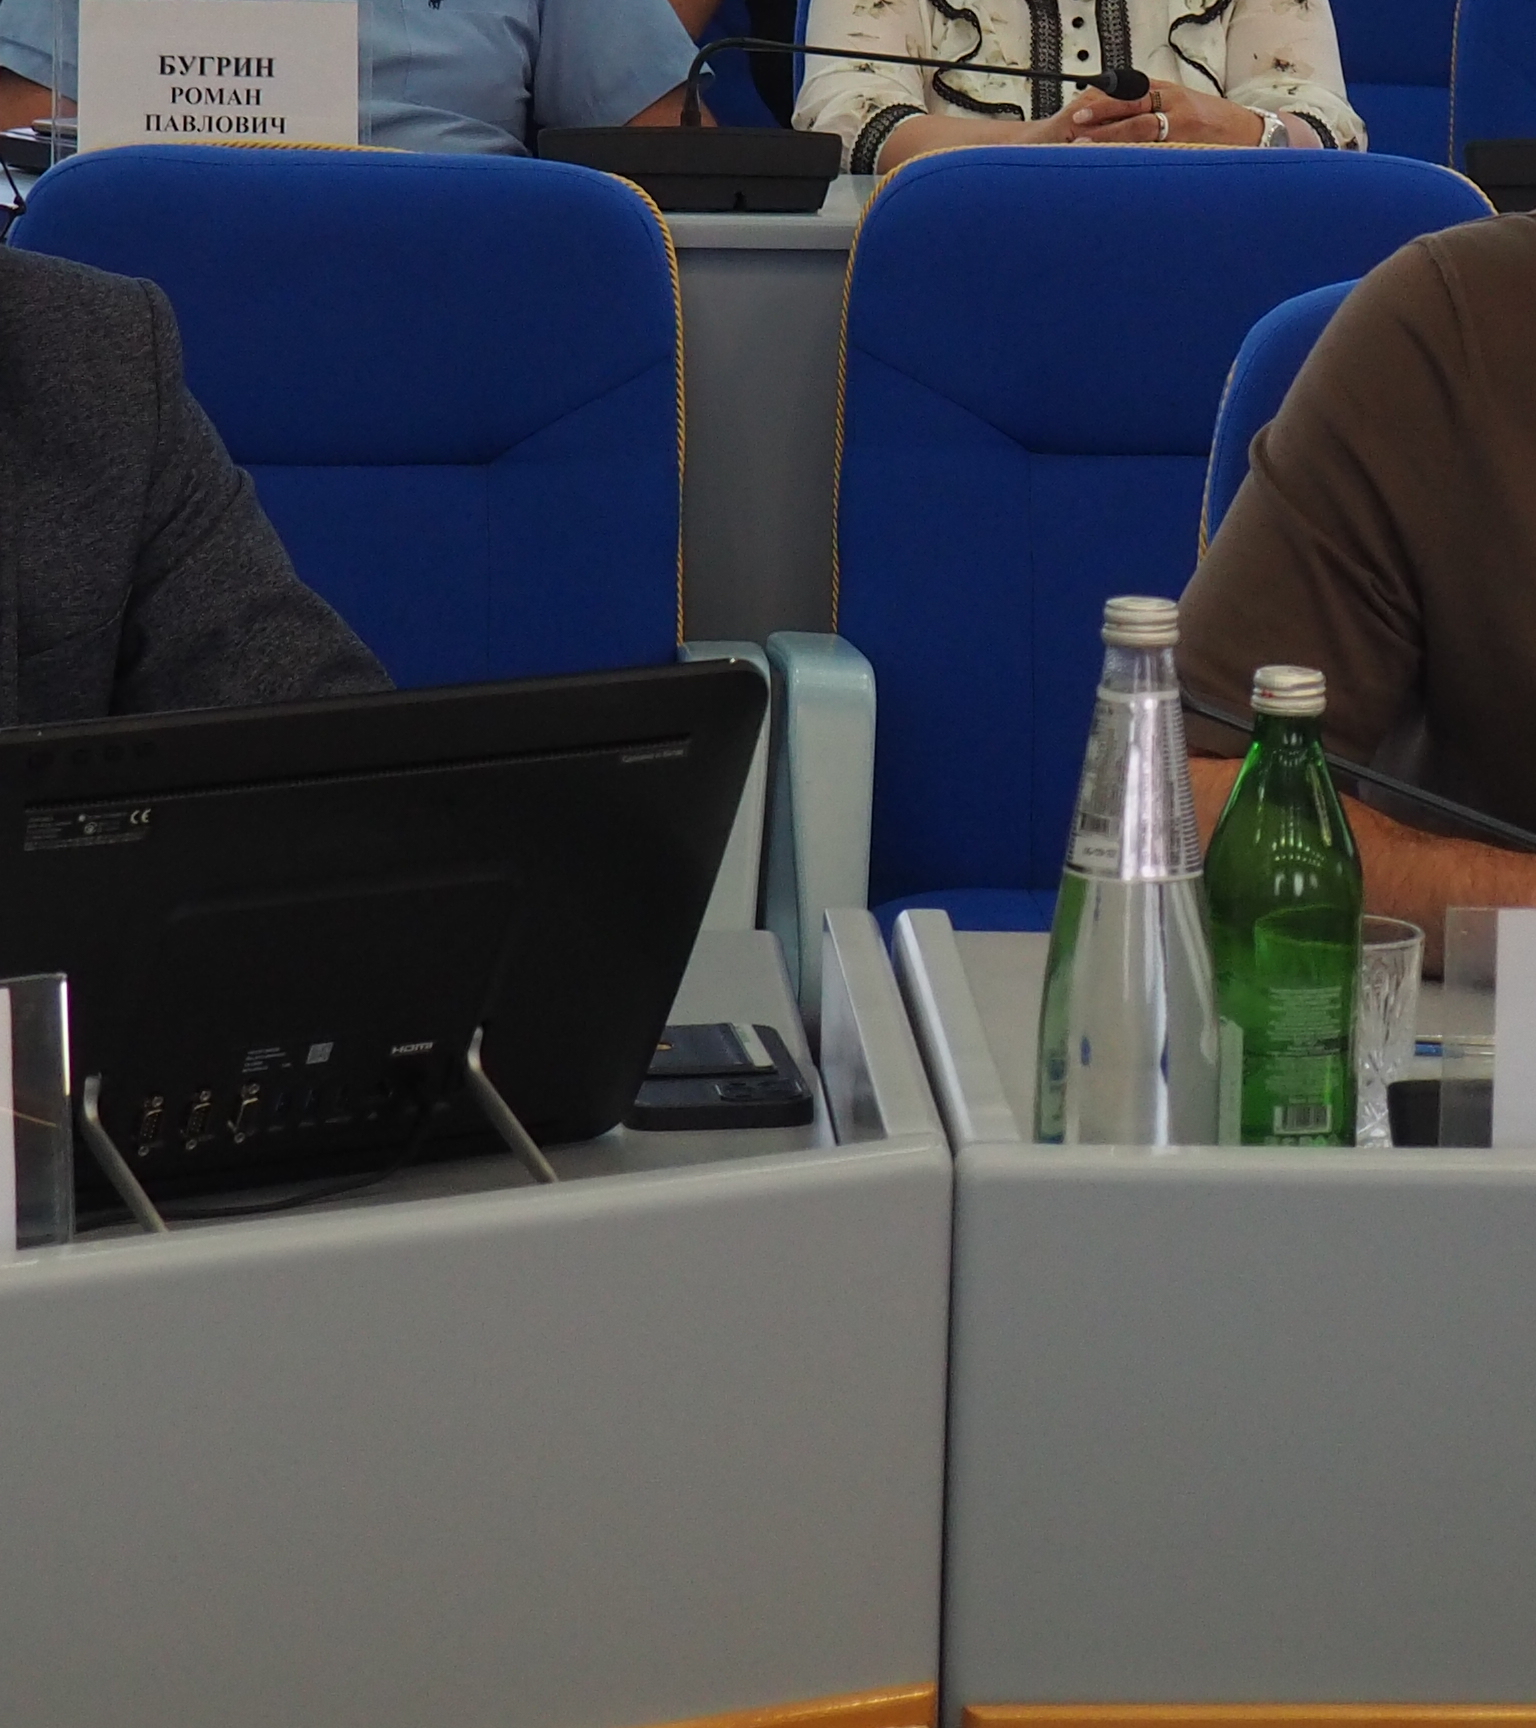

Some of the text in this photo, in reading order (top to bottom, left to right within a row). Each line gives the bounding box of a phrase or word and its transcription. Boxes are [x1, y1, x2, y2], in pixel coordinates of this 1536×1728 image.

[158, 55, 275, 78] БУГРИН
[170, 86, 262, 106] РОМАН
[146, 114, 286, 135] ПАВЛОВИЧ
[391, 1041, 434, 1054] HDMI
